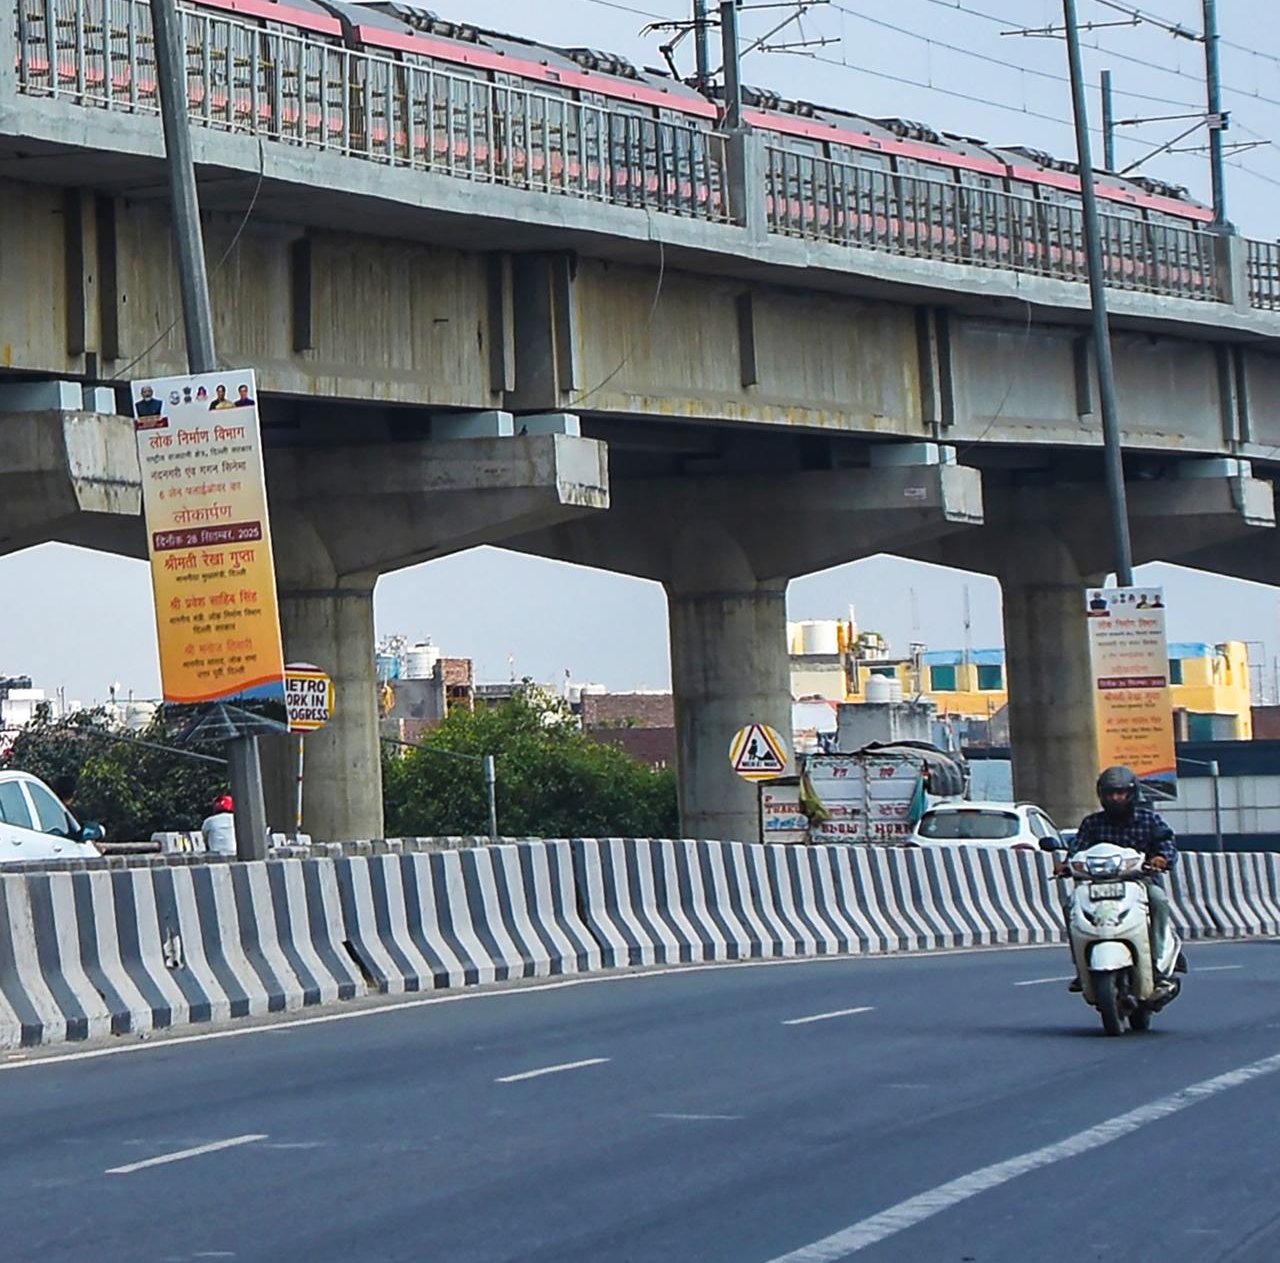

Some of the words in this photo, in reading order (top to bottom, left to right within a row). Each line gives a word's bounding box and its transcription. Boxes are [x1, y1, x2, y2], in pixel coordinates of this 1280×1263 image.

[149, 432, 173, 449] लोक
[178, 427, 210, 446] निर्माण
[214, 425, 245, 442] विभाग
[172, 501, 233, 524] लोकार्पण
[238, 527, 260, 539] 2025
[164, 552, 197, 571] श्रीमती
[201, 550, 224, 567] रेखा
[229, 548, 255, 569] गुप्ता
[287, 693, 308, 707] ORK
[311, 694, 325, 707] IN
[289, 708, 330, 721] OGRESS
[822, 823, 857, 834] BLOW
